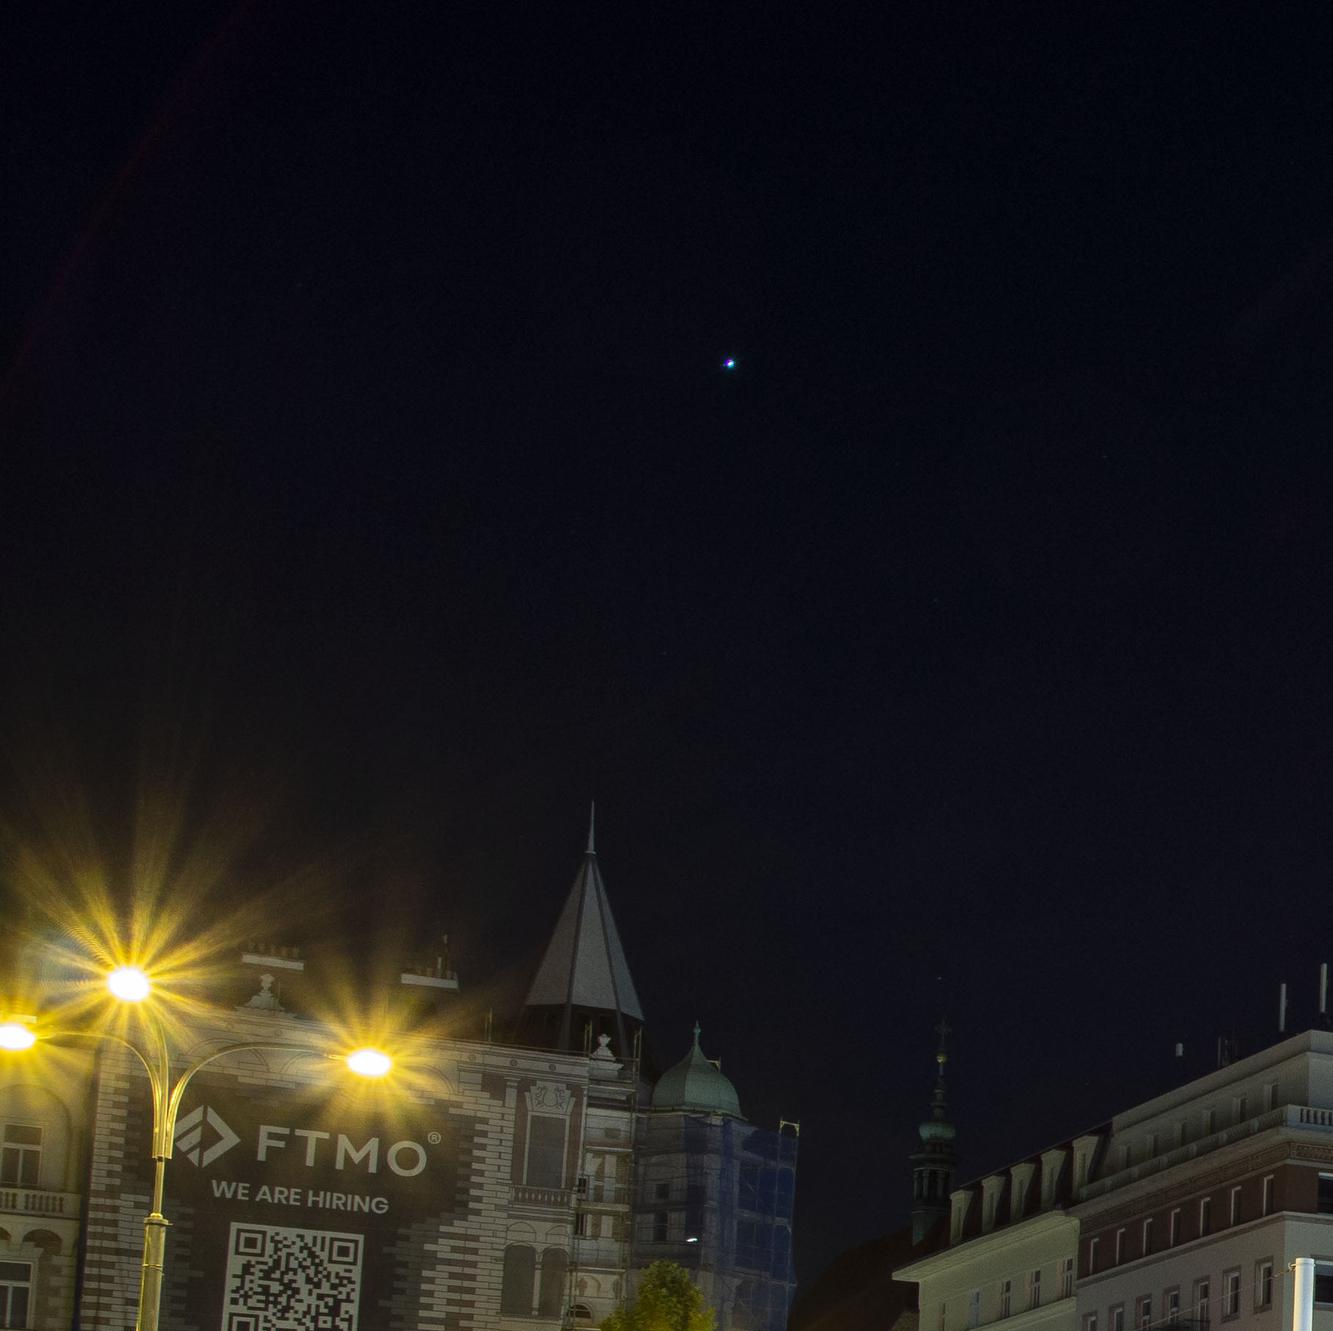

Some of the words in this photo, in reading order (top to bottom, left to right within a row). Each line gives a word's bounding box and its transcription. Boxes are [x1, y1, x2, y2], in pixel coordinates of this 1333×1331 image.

[212, 1180, 250, 1200] WE
[256, 1185, 301, 1205] ARE
[308, 1190, 389, 1214] HIRING
